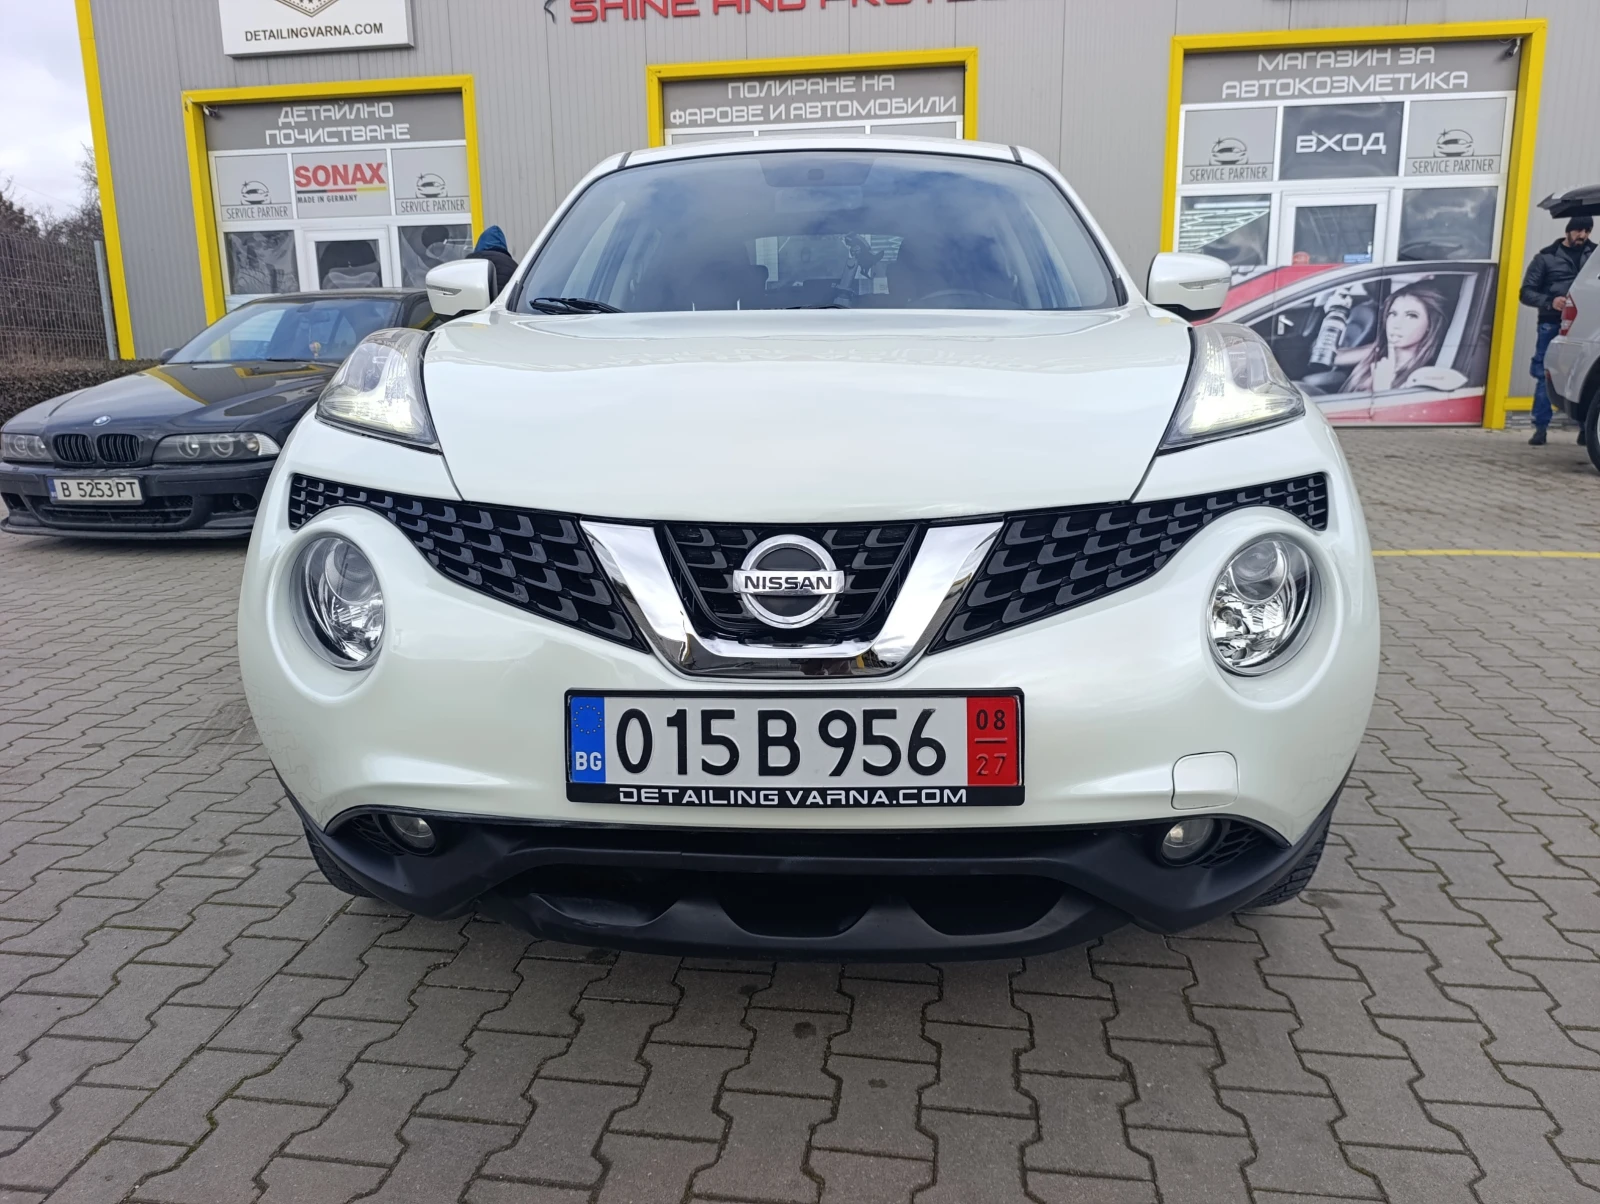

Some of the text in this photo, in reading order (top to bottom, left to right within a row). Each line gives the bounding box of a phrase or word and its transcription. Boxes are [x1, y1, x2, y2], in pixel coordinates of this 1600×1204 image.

[570, 0, 701, 23] SHINE
[244, 22, 384, 43] DETAILINGVARNA.COM
[1257, 46, 1436, 72] МАГАЗИН ЗА
[728, 75, 895, 99] ПОЛИРАНЕ НА
[1221, 71, 1469, 100] АВТОКОЗМЕТИКА
[277, 101, 394, 127] ДЕТАЙЛНО
[669, 96, 957, 126] ФАРОВЕ И АВТОМОБИЛИ
[265, 123, 411, 146] ПОЧИСТВАНЕ
[1295, 132, 1387, 155] ВХОД
[294, 162, 387, 188] SONAX
[1189, 167, 1268, 182] SERVICE PARTNER
[1412, 158, 1494, 174] SERVICE PARTNER
[326, 194, 358, 203] GERMANY
[400, 198, 465, 213] SERVICE PARTNER
[226, 205, 288, 219] SERVICE PARTNER
[744, 575, 832, 590] NISSAN
[975, 708, 1007, 731] 08
[575, 751, 602, 771] BG
[975, 752, 1007, 776] 27
[619, 787, 967, 805] DETAILINGVARNA.COM
